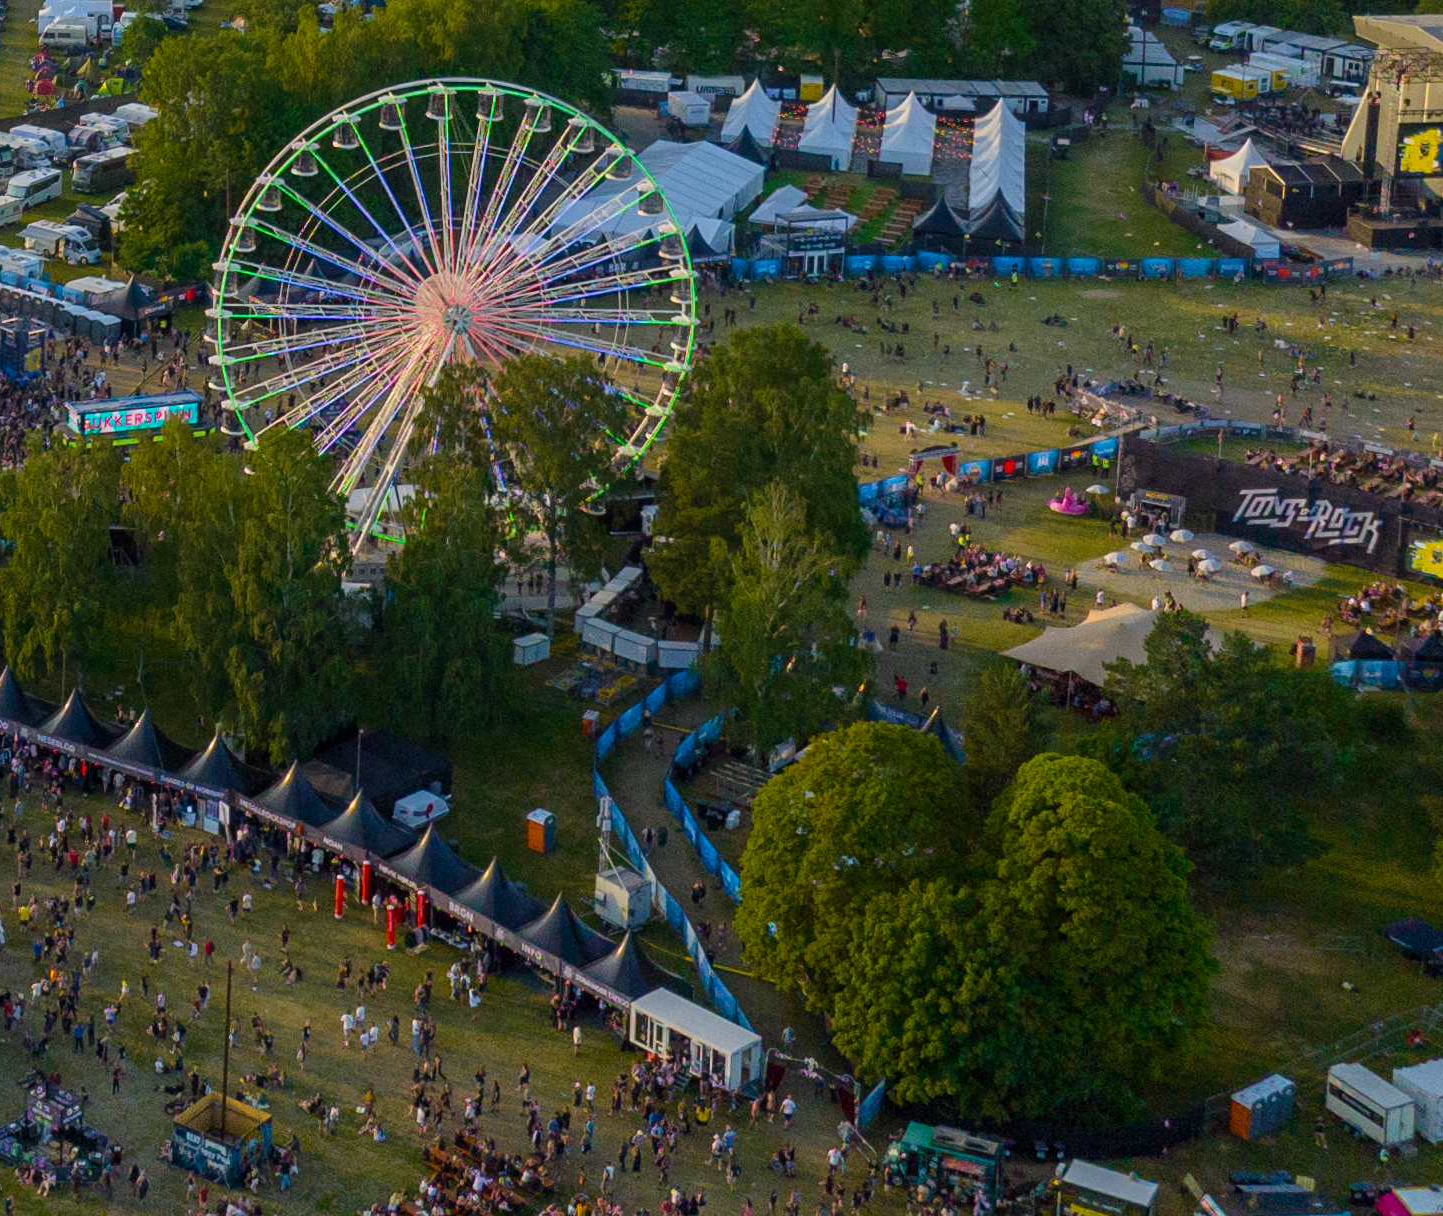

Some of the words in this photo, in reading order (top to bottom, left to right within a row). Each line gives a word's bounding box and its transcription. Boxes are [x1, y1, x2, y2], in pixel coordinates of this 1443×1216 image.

[84, 409, 192, 430] SUKKERSPINN
[1304, 499, 1384, 554] ROCK
[521, 941, 543, 961] INFO
